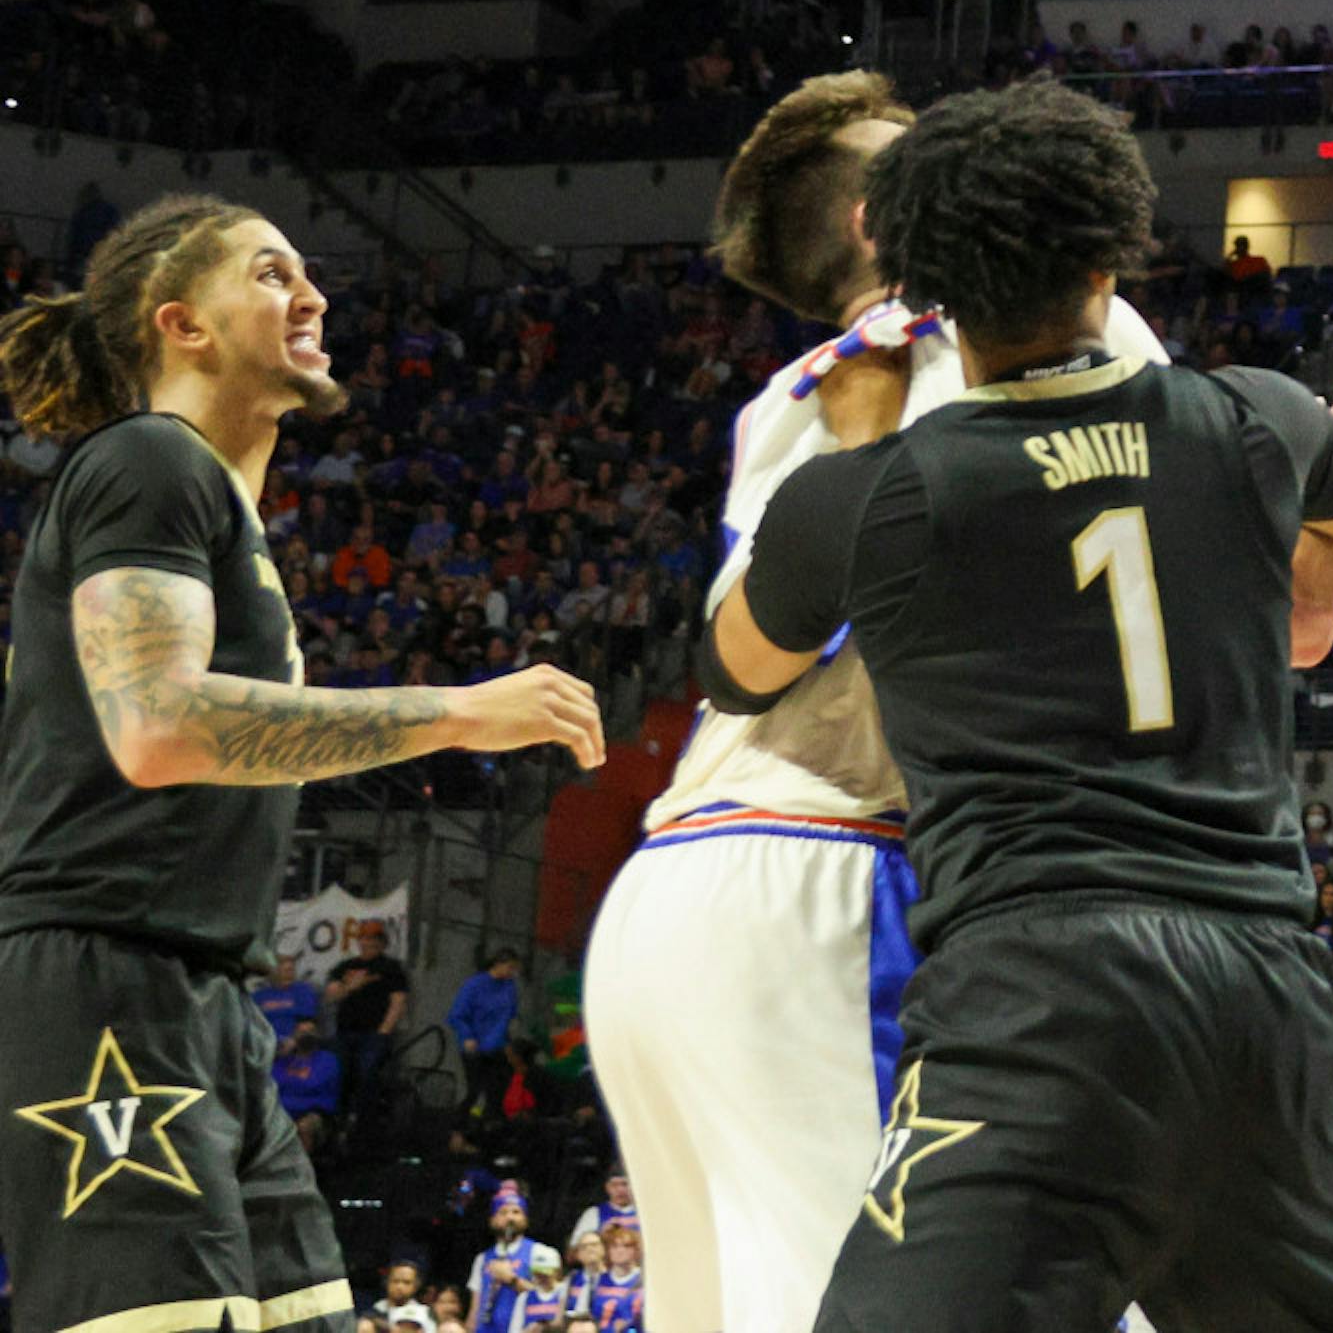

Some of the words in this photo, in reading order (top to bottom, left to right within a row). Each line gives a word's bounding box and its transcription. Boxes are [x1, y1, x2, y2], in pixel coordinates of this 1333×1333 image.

[1023, 422, 1150, 490] SMITH
[1071, 505, 1175, 733] 1
[87, 1096, 142, 1157] V
